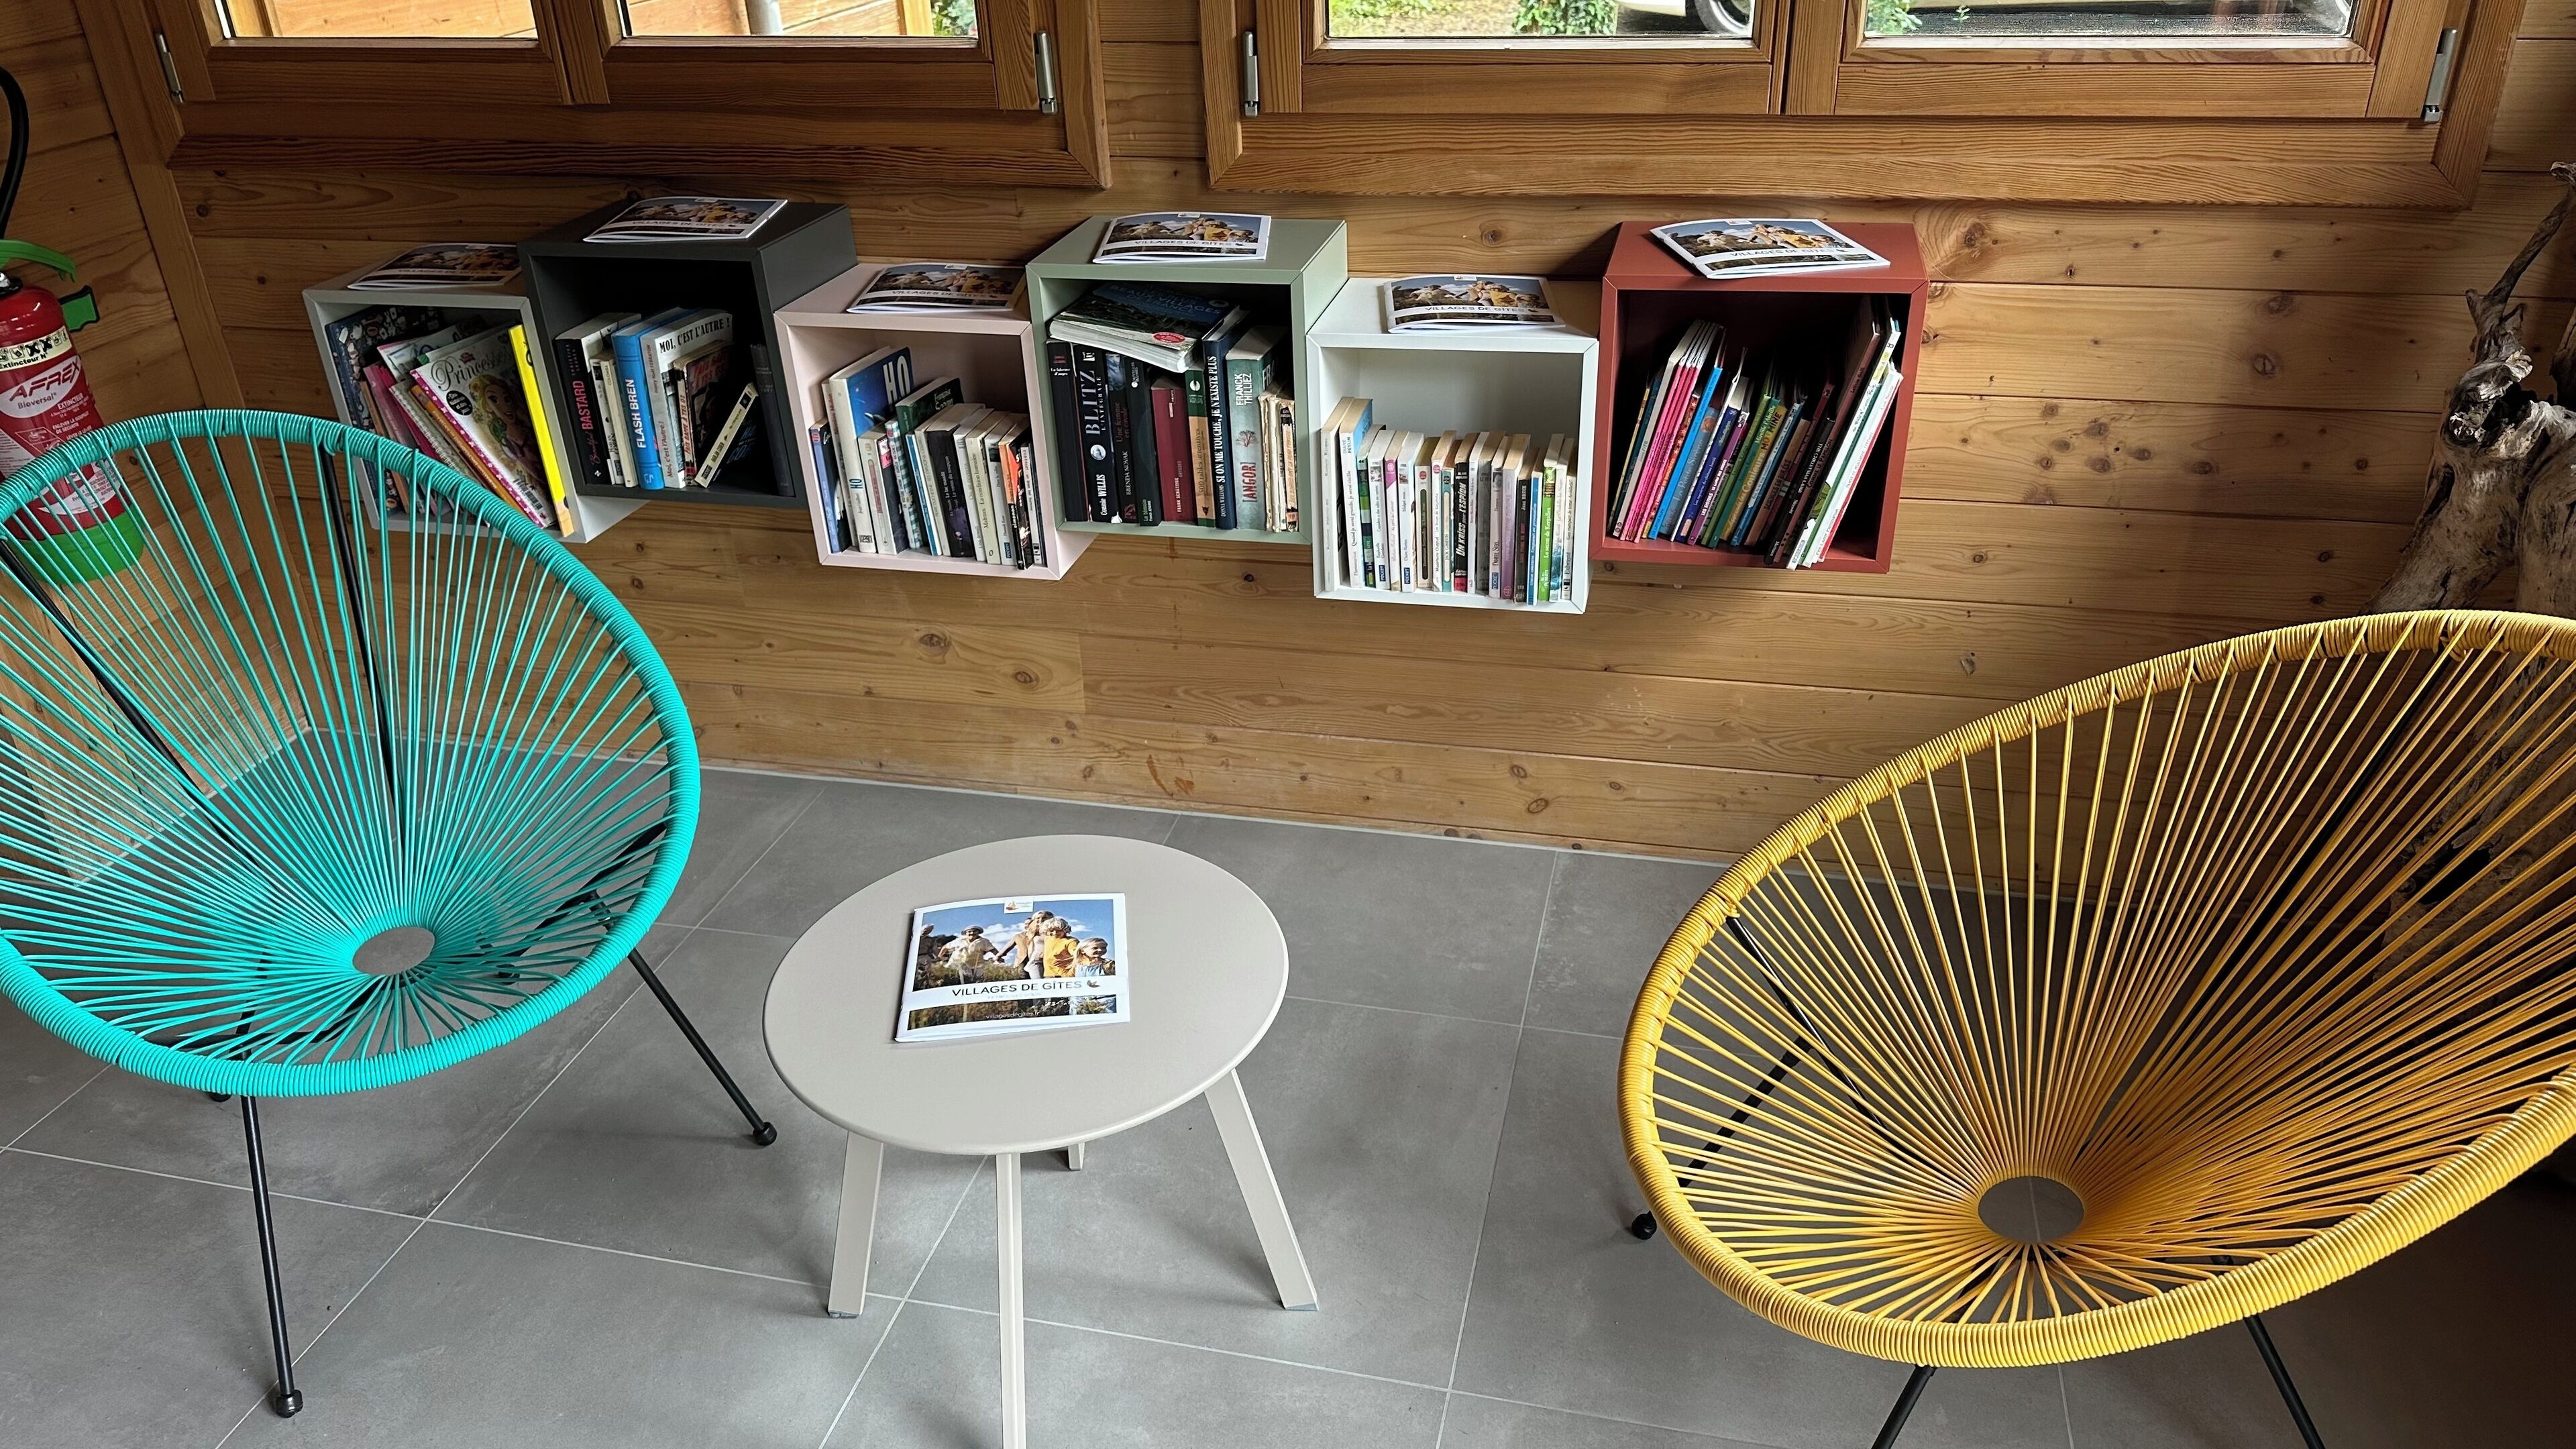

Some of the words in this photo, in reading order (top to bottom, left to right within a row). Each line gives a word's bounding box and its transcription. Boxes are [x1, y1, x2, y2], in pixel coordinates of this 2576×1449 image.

[1157, 296, 1222, 315] VILLAGES
[659, 340, 677, 354] MOI,
[677, 331, 694, 347] C'EST
[696, 319, 725, 339] L'AUTRE
[1206, 354, 1218, 374] PLUS
[883, 355, 910, 406] HO
[1208, 374, 1220, 407] N'EXISTE
[1233, 372, 1244, 406] FRANCK
[1242, 372, 1254, 404] THILLIEZ
[572, 378, 594, 432] BASTARD
[623, 376, 640, 411] BREN
[1079, 368, 1102, 437] BLITZ
[1112, 402, 1122, 425] femme
[1211, 407, 1222, 418] JE
[630, 411, 647, 449] FLASH
[1115, 427, 1124, 443] Une
[1212, 417, 1224, 450] TOUCHE,
[1121, 450, 1130, 472] NOVAK
[1214, 451, 1224, 462] ME
[1214, 463, 1224, 474] ON
[1216, 475, 1225, 484] SI
[1740, 449, 1766, 494] Couleurs
[849, 476, 863, 491] HO
[1095, 473, 1108, 497] WILLIS
[1124, 472, 1132, 495] BRENDA
[1703, 492, 1713, 508] SISTERS
[1010, 504, 1018, 529] simenon
[951, 983, 1017, 996] VILLAGES
[1020, 982, 1038, 991] DE
[1041, 978, 1082, 991] GÎTES
